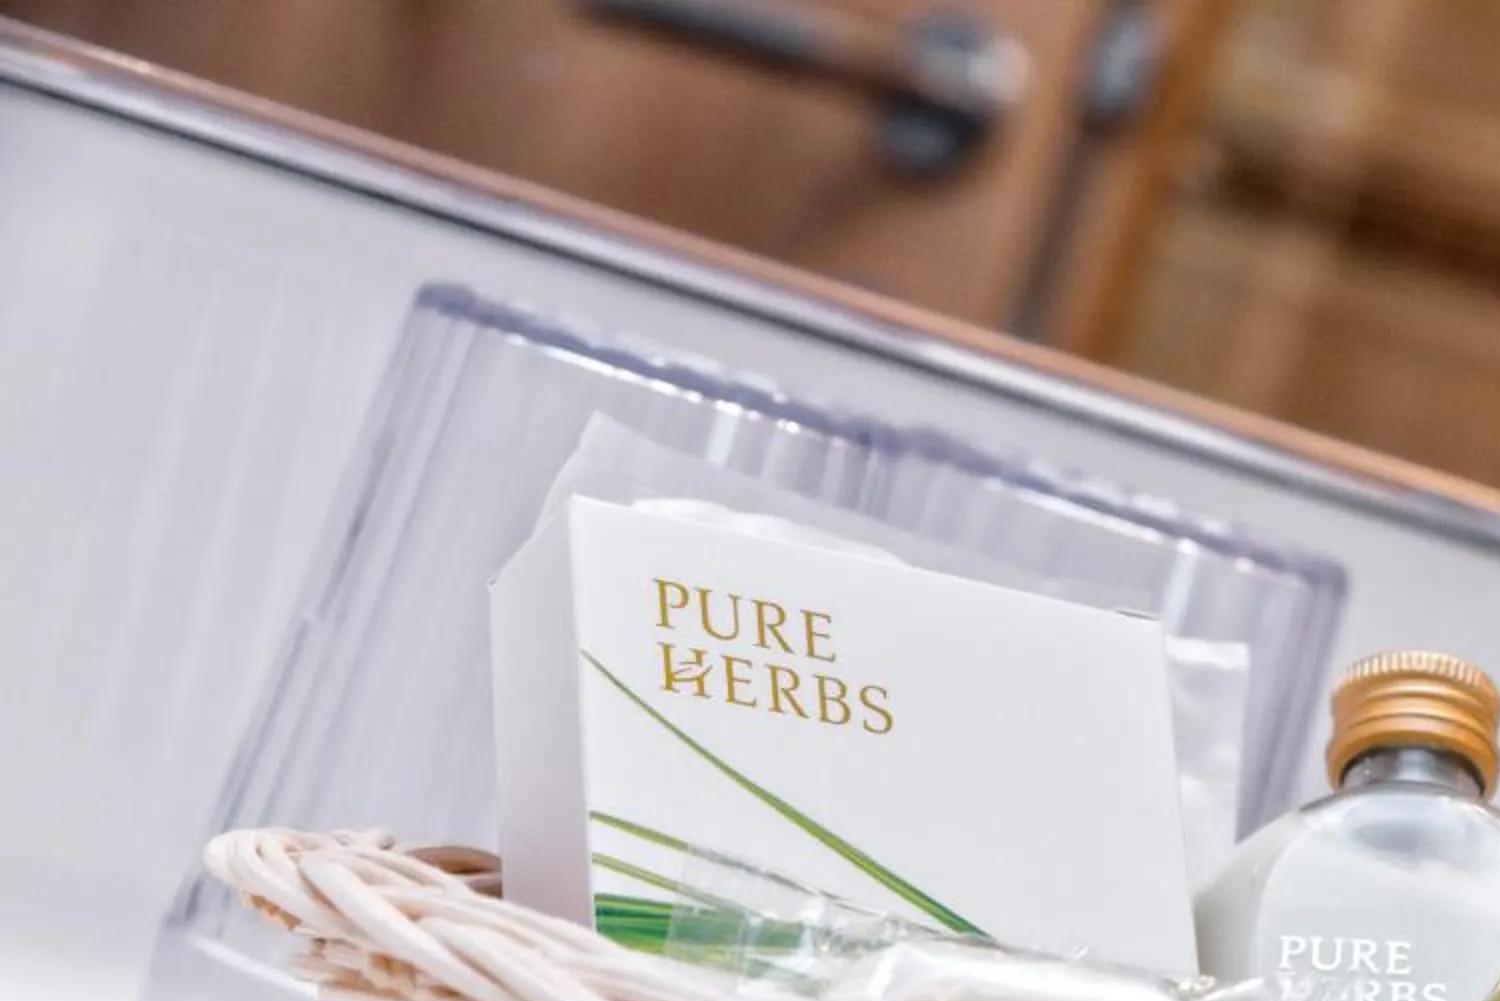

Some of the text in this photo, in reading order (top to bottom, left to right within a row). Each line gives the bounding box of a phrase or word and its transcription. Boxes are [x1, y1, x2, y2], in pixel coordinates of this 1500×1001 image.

[652, 576, 837, 663] PURE
[656, 641, 894, 735] HERBS
[1277, 934, 1413, 975] PURE
